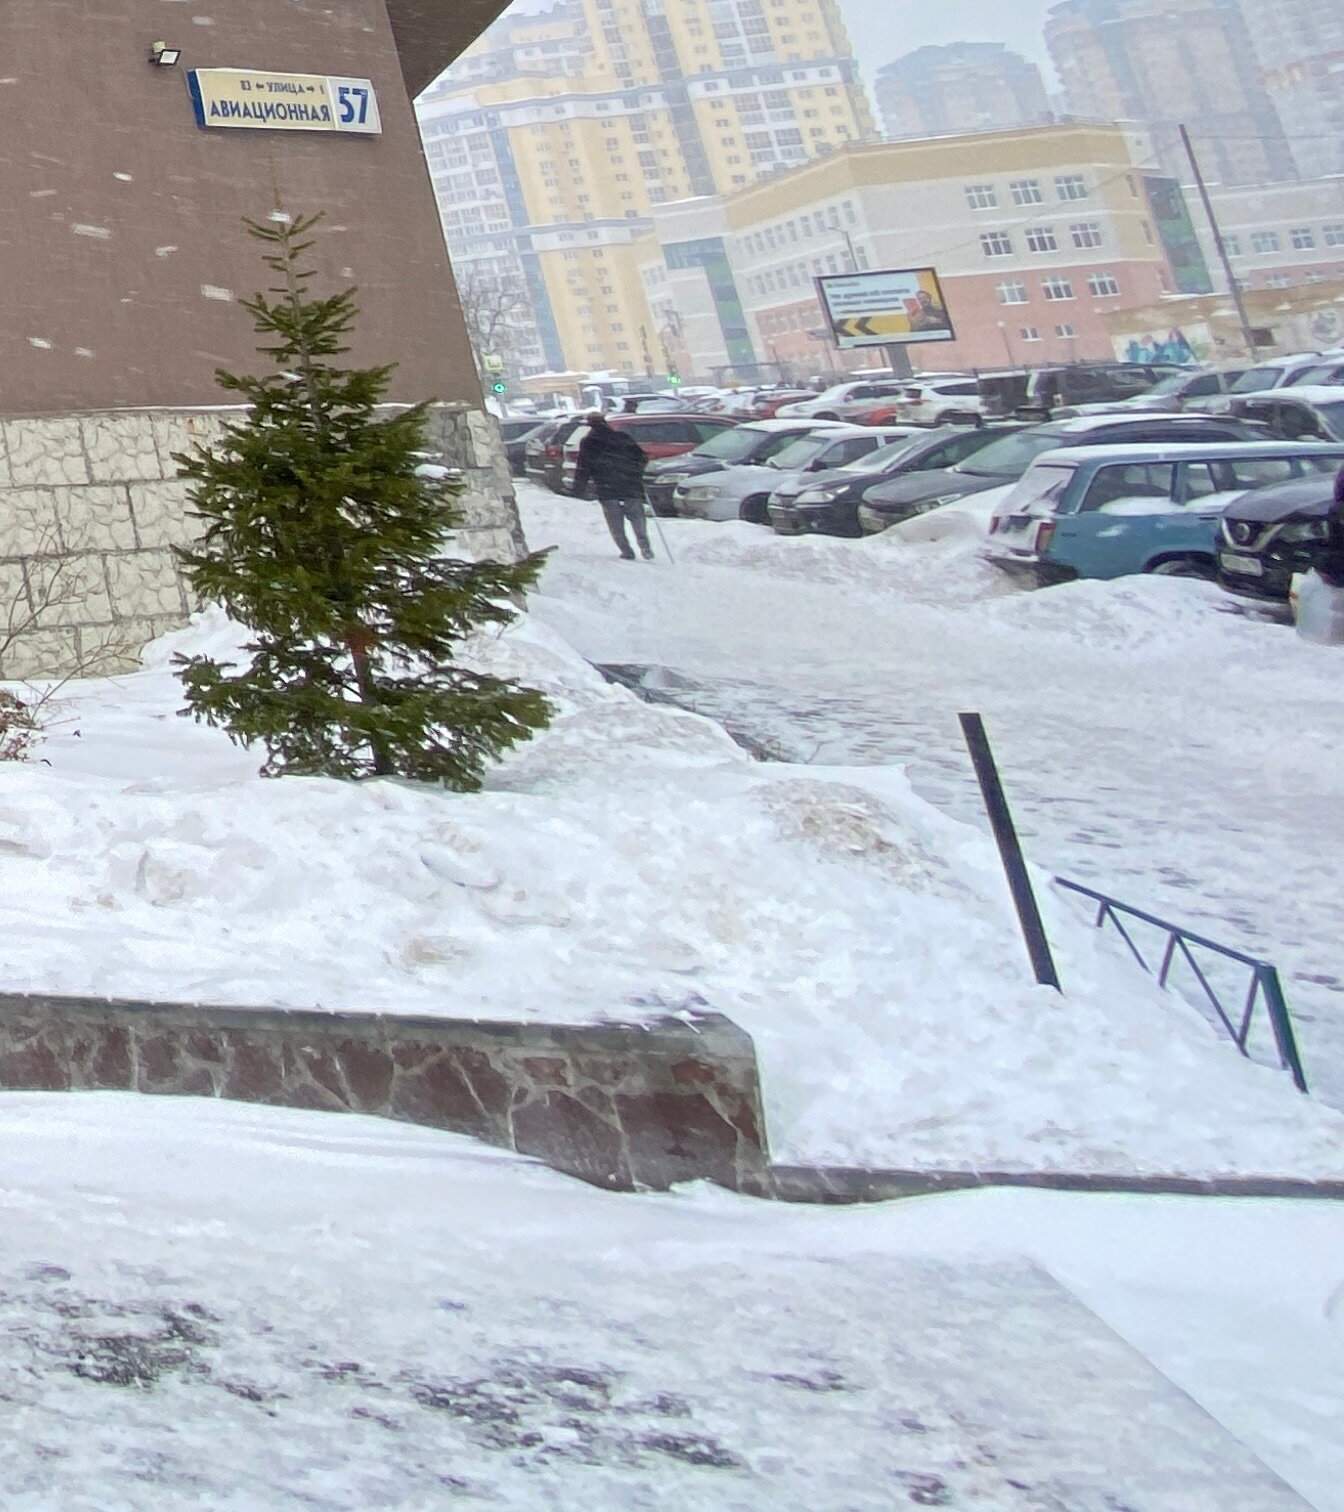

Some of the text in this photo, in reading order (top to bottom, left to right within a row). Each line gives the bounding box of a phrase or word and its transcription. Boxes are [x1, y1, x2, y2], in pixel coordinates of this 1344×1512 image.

[266, 81, 306, 96] УЛИЦА
[210, 100, 331, 123] АВИАЦИОННАЯ
[338, 86, 369, 124] 57
